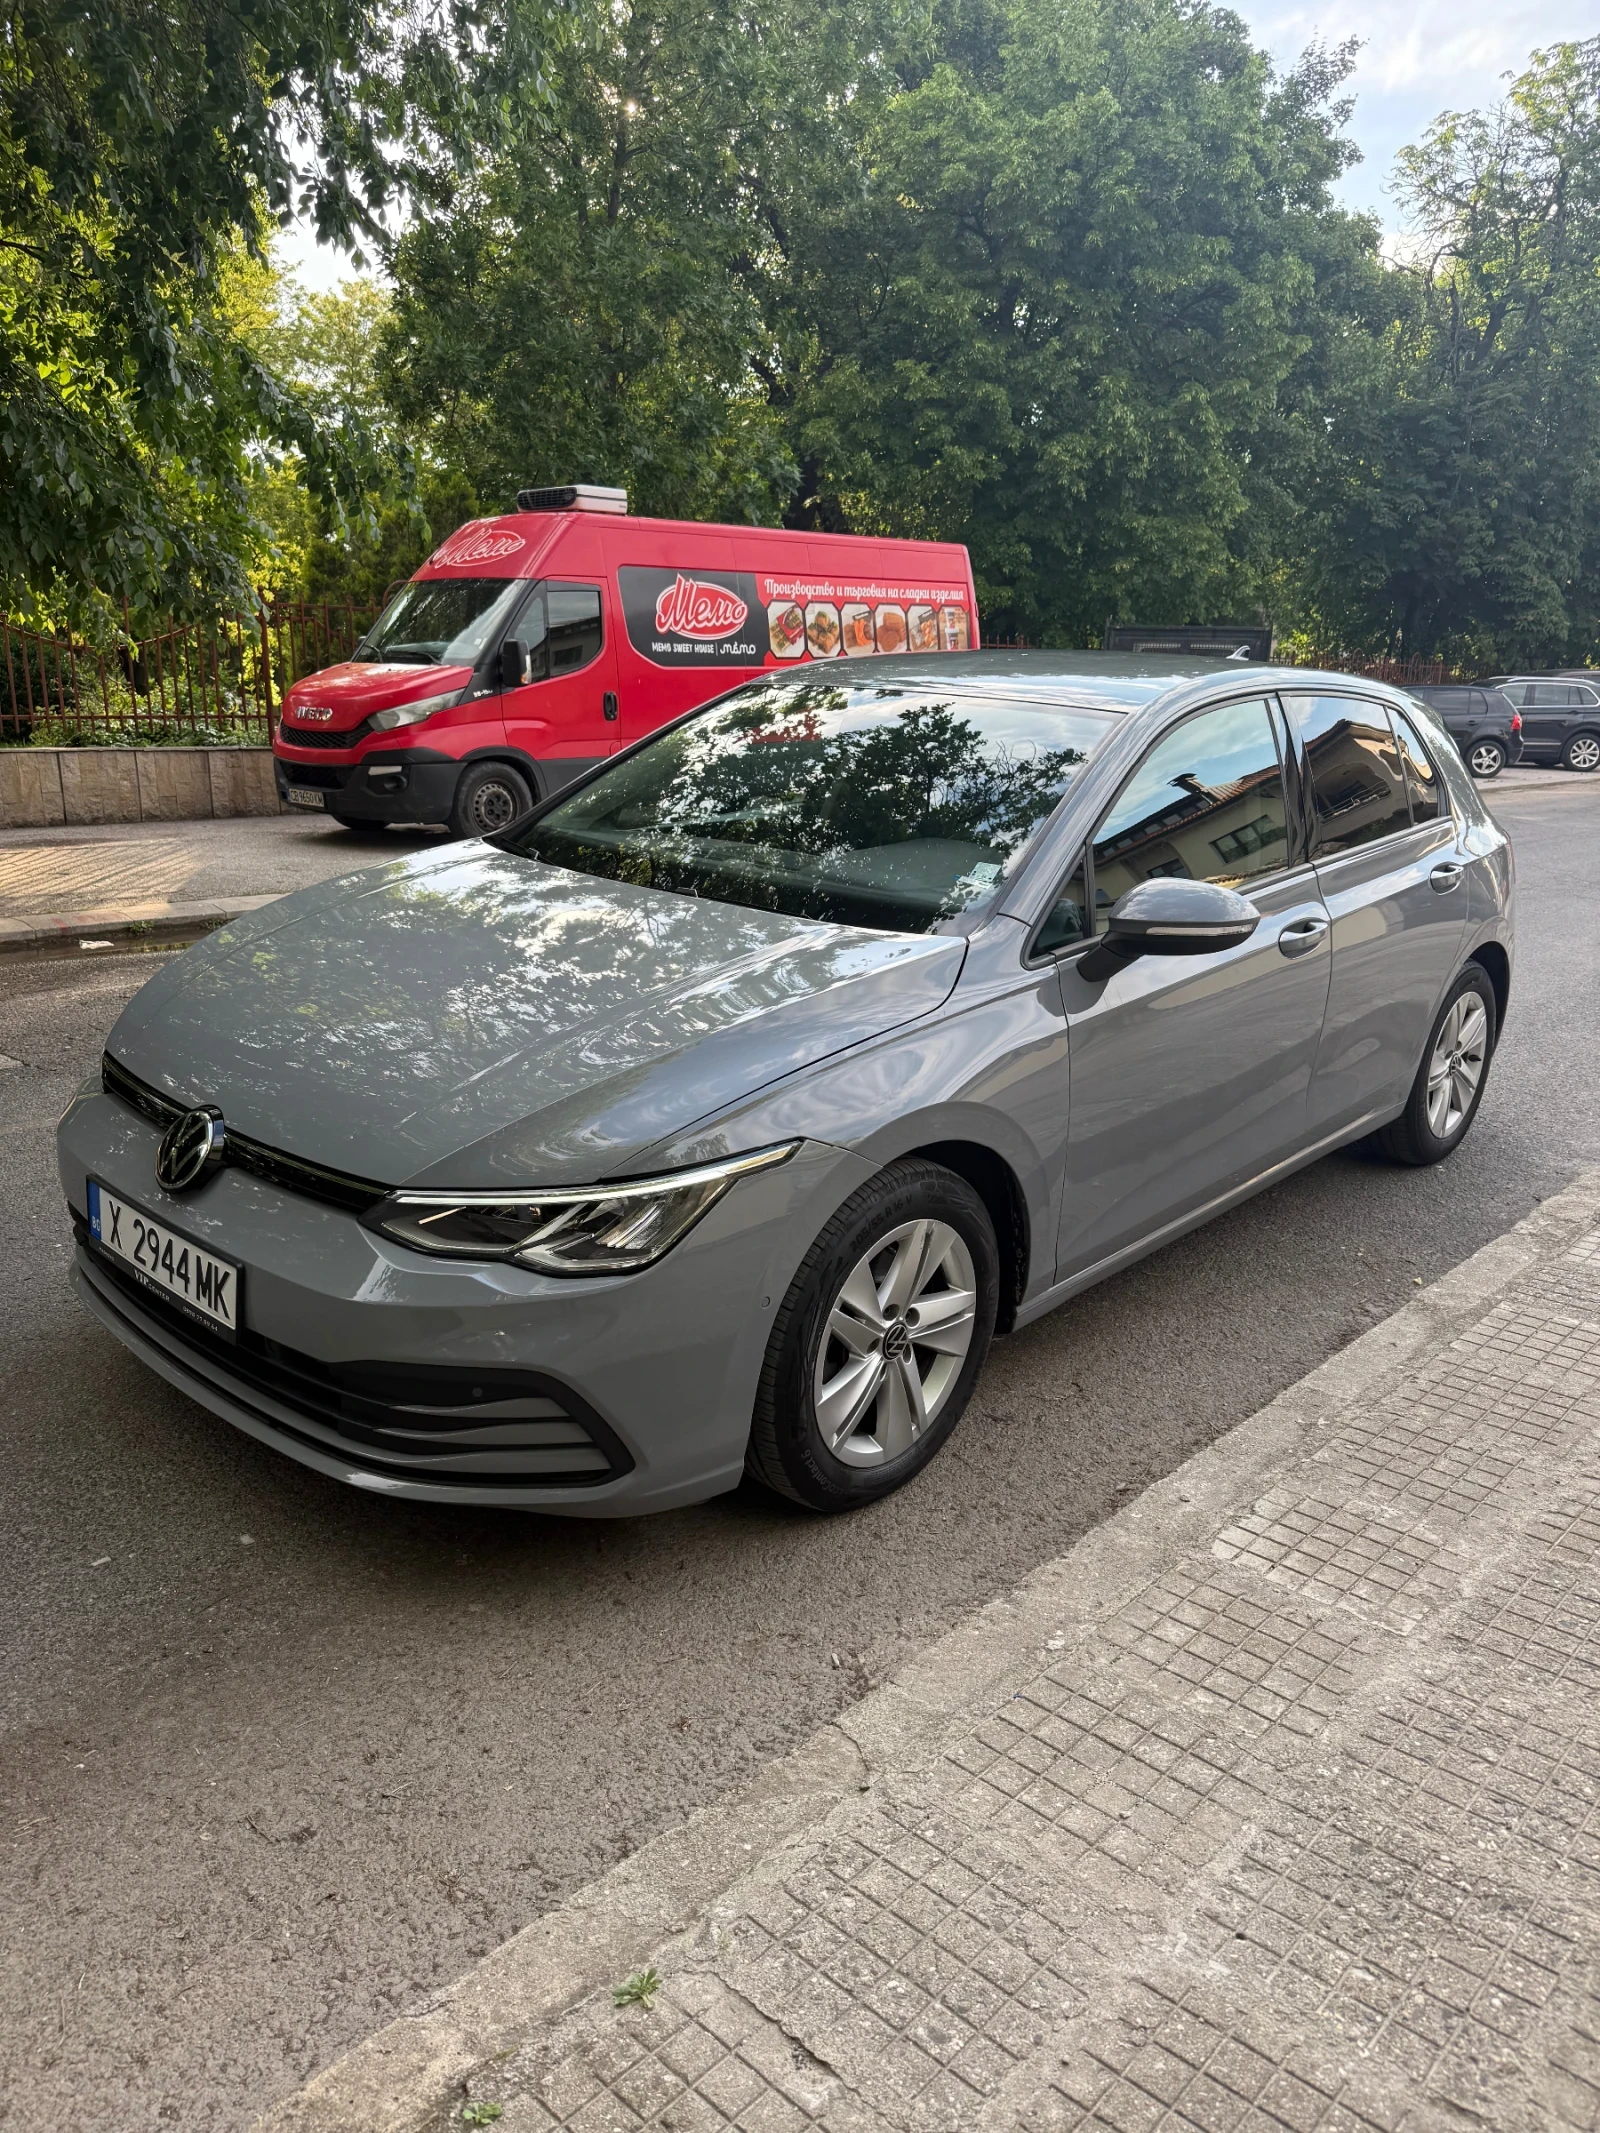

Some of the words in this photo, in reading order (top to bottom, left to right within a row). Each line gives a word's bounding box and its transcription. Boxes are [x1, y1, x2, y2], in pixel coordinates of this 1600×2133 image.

[764, 578, 835, 600] Производство
[836, 585, 843, 597] и
[844, 583, 887, 602] търговия
[888, 588, 899, 598] на
[900, 588, 930, 603] сладки
[931, 589, 964, 604] изделия
[651, 641, 671, 653] MEMO
[673, 642, 693, 653] SWEET
[694, 643, 714, 654] HOUSE
[295, 705, 333, 720] IVECO
[91, 1215, 101, 1232] BG
[109, 1200, 122, 1250] X
[134, 1268, 149, 1286] VIP
